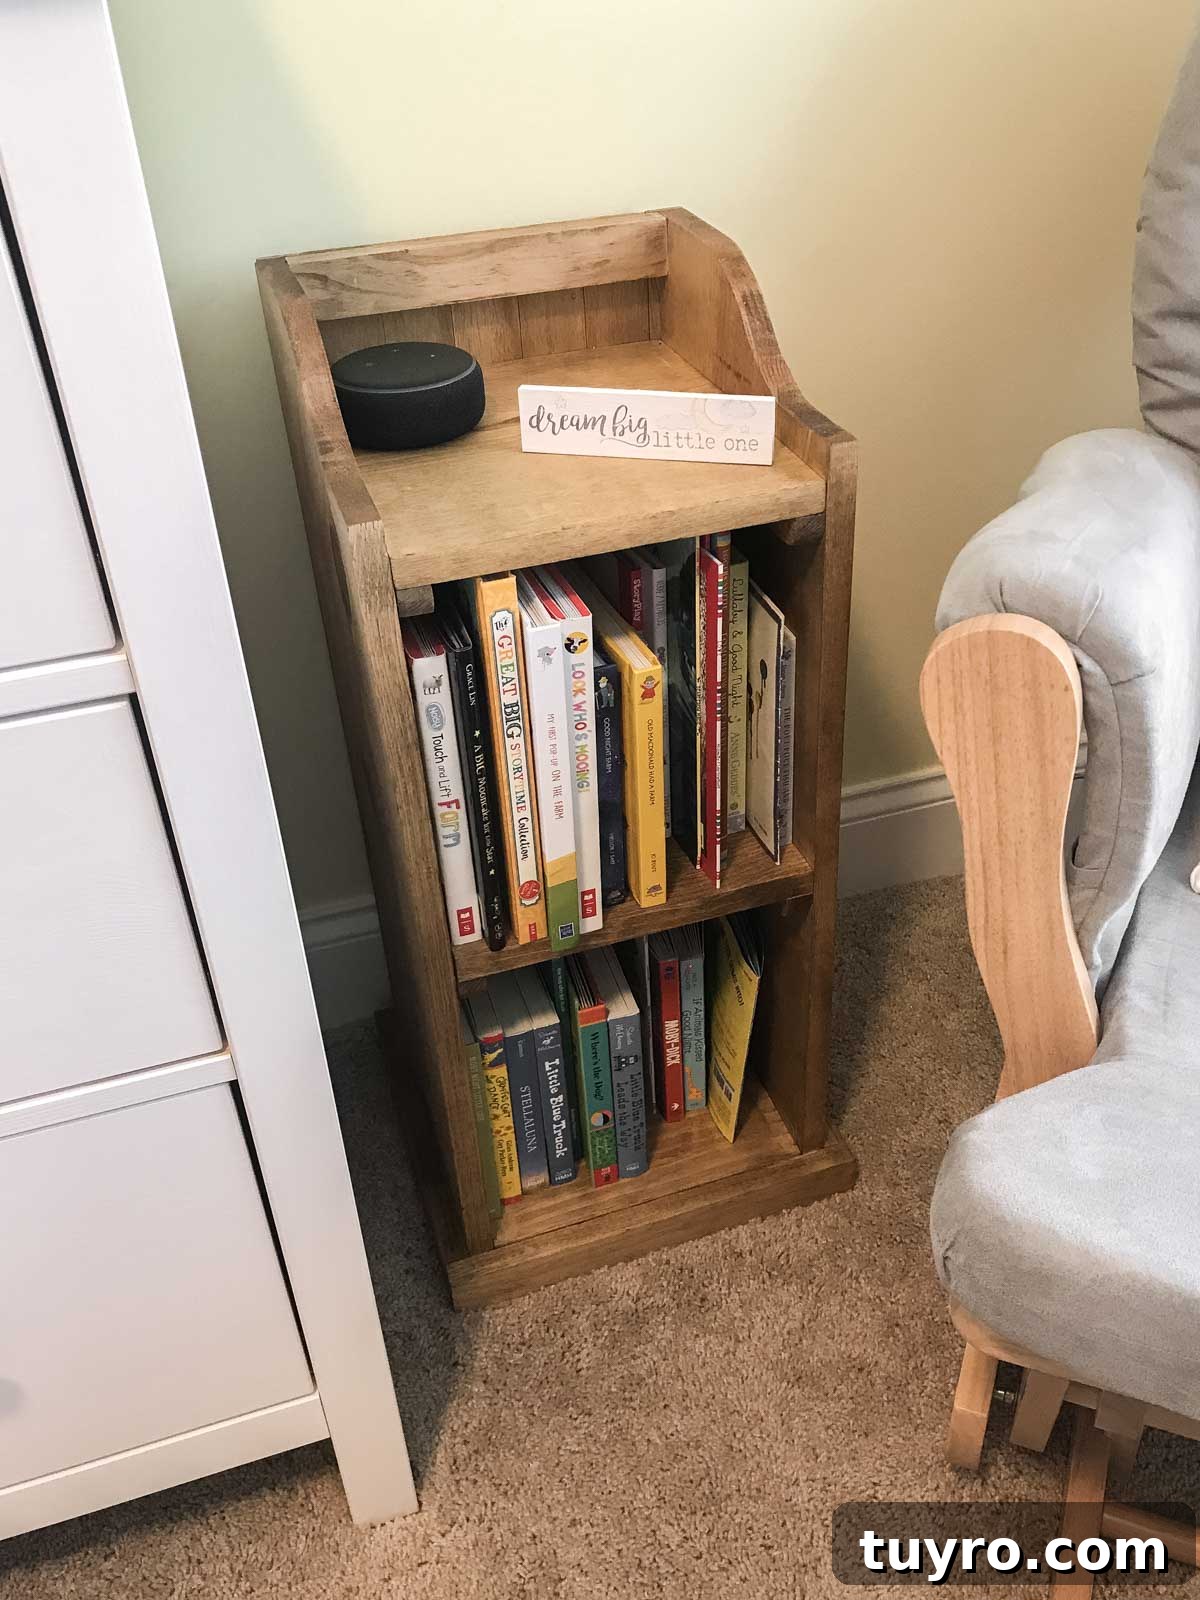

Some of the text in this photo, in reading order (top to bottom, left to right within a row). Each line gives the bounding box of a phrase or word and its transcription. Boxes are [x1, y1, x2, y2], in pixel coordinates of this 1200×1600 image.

[528, 404, 650, 448] dream big
[652, 431, 759, 452] little one
[729, 644, 744, 672] Good
[497, 634, 523, 739] GREAT BIG
[571, 662, 587, 698] LOOK
[730, 673, 743, 709] Night
[572, 700, 592, 742] WHO'S
[473, 744, 482, 753] A
[474, 755, 486, 775] BIG
[547, 713, 564, 820] MY FIRST POP-UP ON THE FARM
[432, 733, 461, 849] Touch and Lift Farm
[510, 742, 527, 813] STORYTIME
[476, 776, 490, 822] Mooncake
[485, 847, 494, 864] Star
[517, 816, 531, 862] Collection
[682, 1009, 692, 1031] Good
[664, 1019, 681, 1067] MOBY-DICK
[544, 1058, 561, 1094] Little
[592, 1066, 602, 1080] the
[630, 1071, 642, 1098] Little
[519, 1085, 537, 1153] STELLALUNA
[549, 1094, 564, 1121] Blue
[618, 1110, 631, 1127] the
[631, 1098, 643, 1120] Blue
[552, 1119, 568, 1159] Truck
